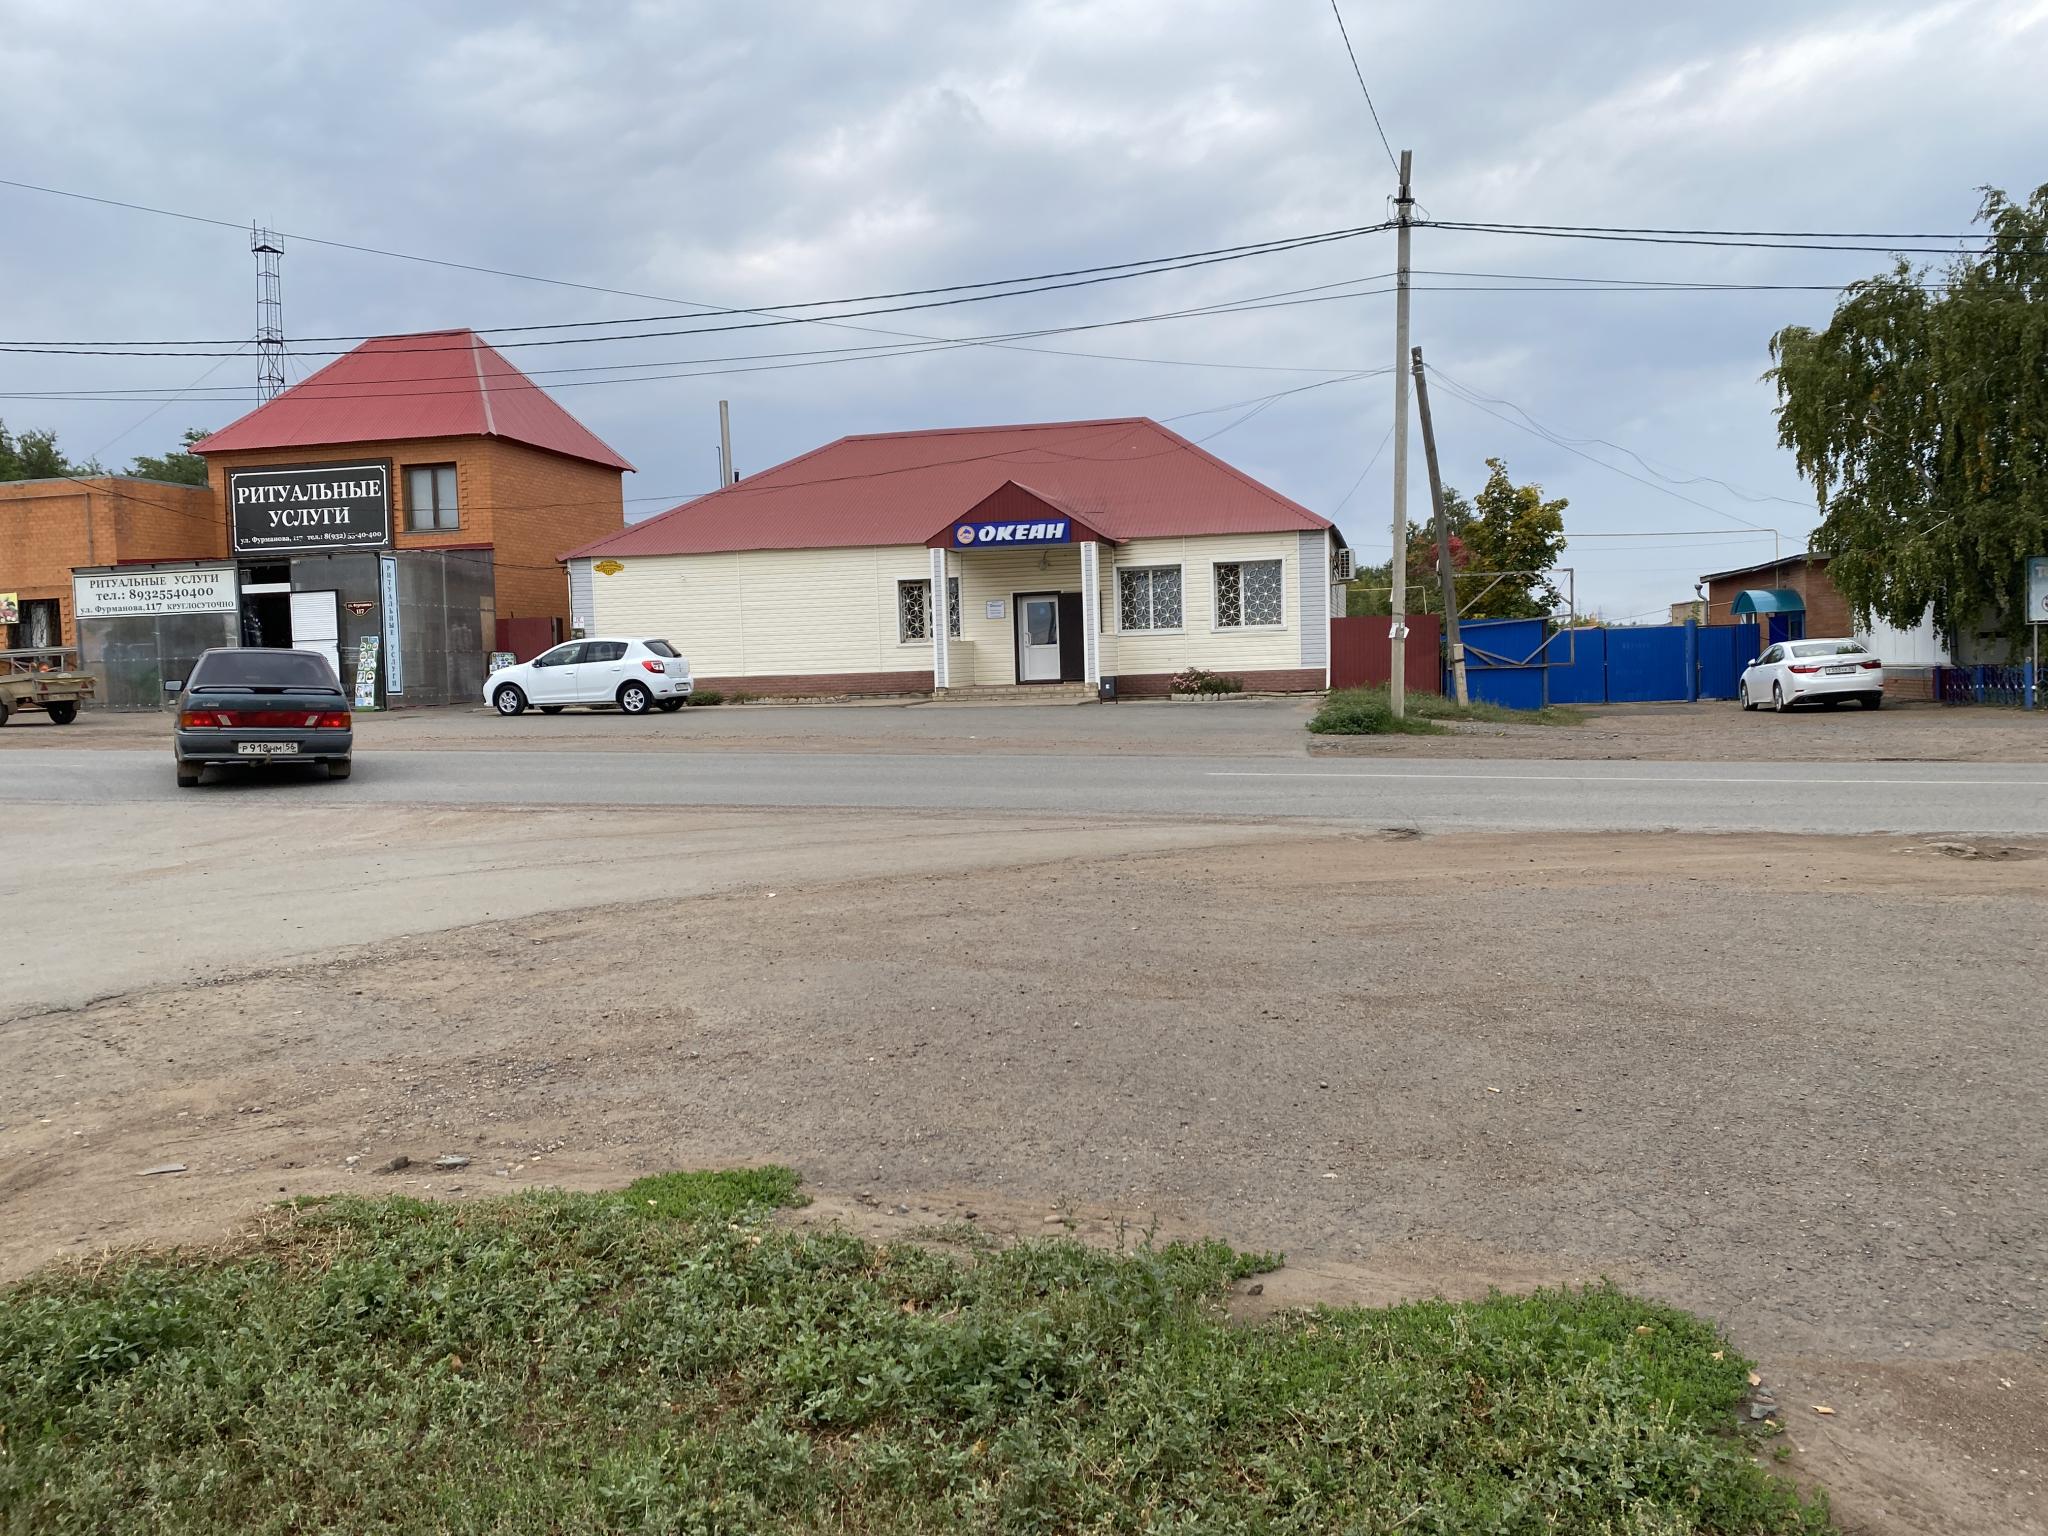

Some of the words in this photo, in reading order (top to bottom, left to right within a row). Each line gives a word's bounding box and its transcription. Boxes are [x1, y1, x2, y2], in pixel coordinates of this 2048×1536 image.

[237, 480, 381, 504] РИТУАЛЬНЫЕ
[268, 507, 350, 527] УСЛУГИ
[978, 522, 1065, 541] ОКЕАН
[90, 576, 167, 589] РИТУАЛЬНЫЕ
[174, 573, 219, 585] УСЛУГИ
[96, 590, 126, 601] тел.:
[129, 587, 214, 601] 89325540400
[80, 607, 93, 615] ул.
[167, 601, 234, 611] КРУГЛОСУТОЧНО
